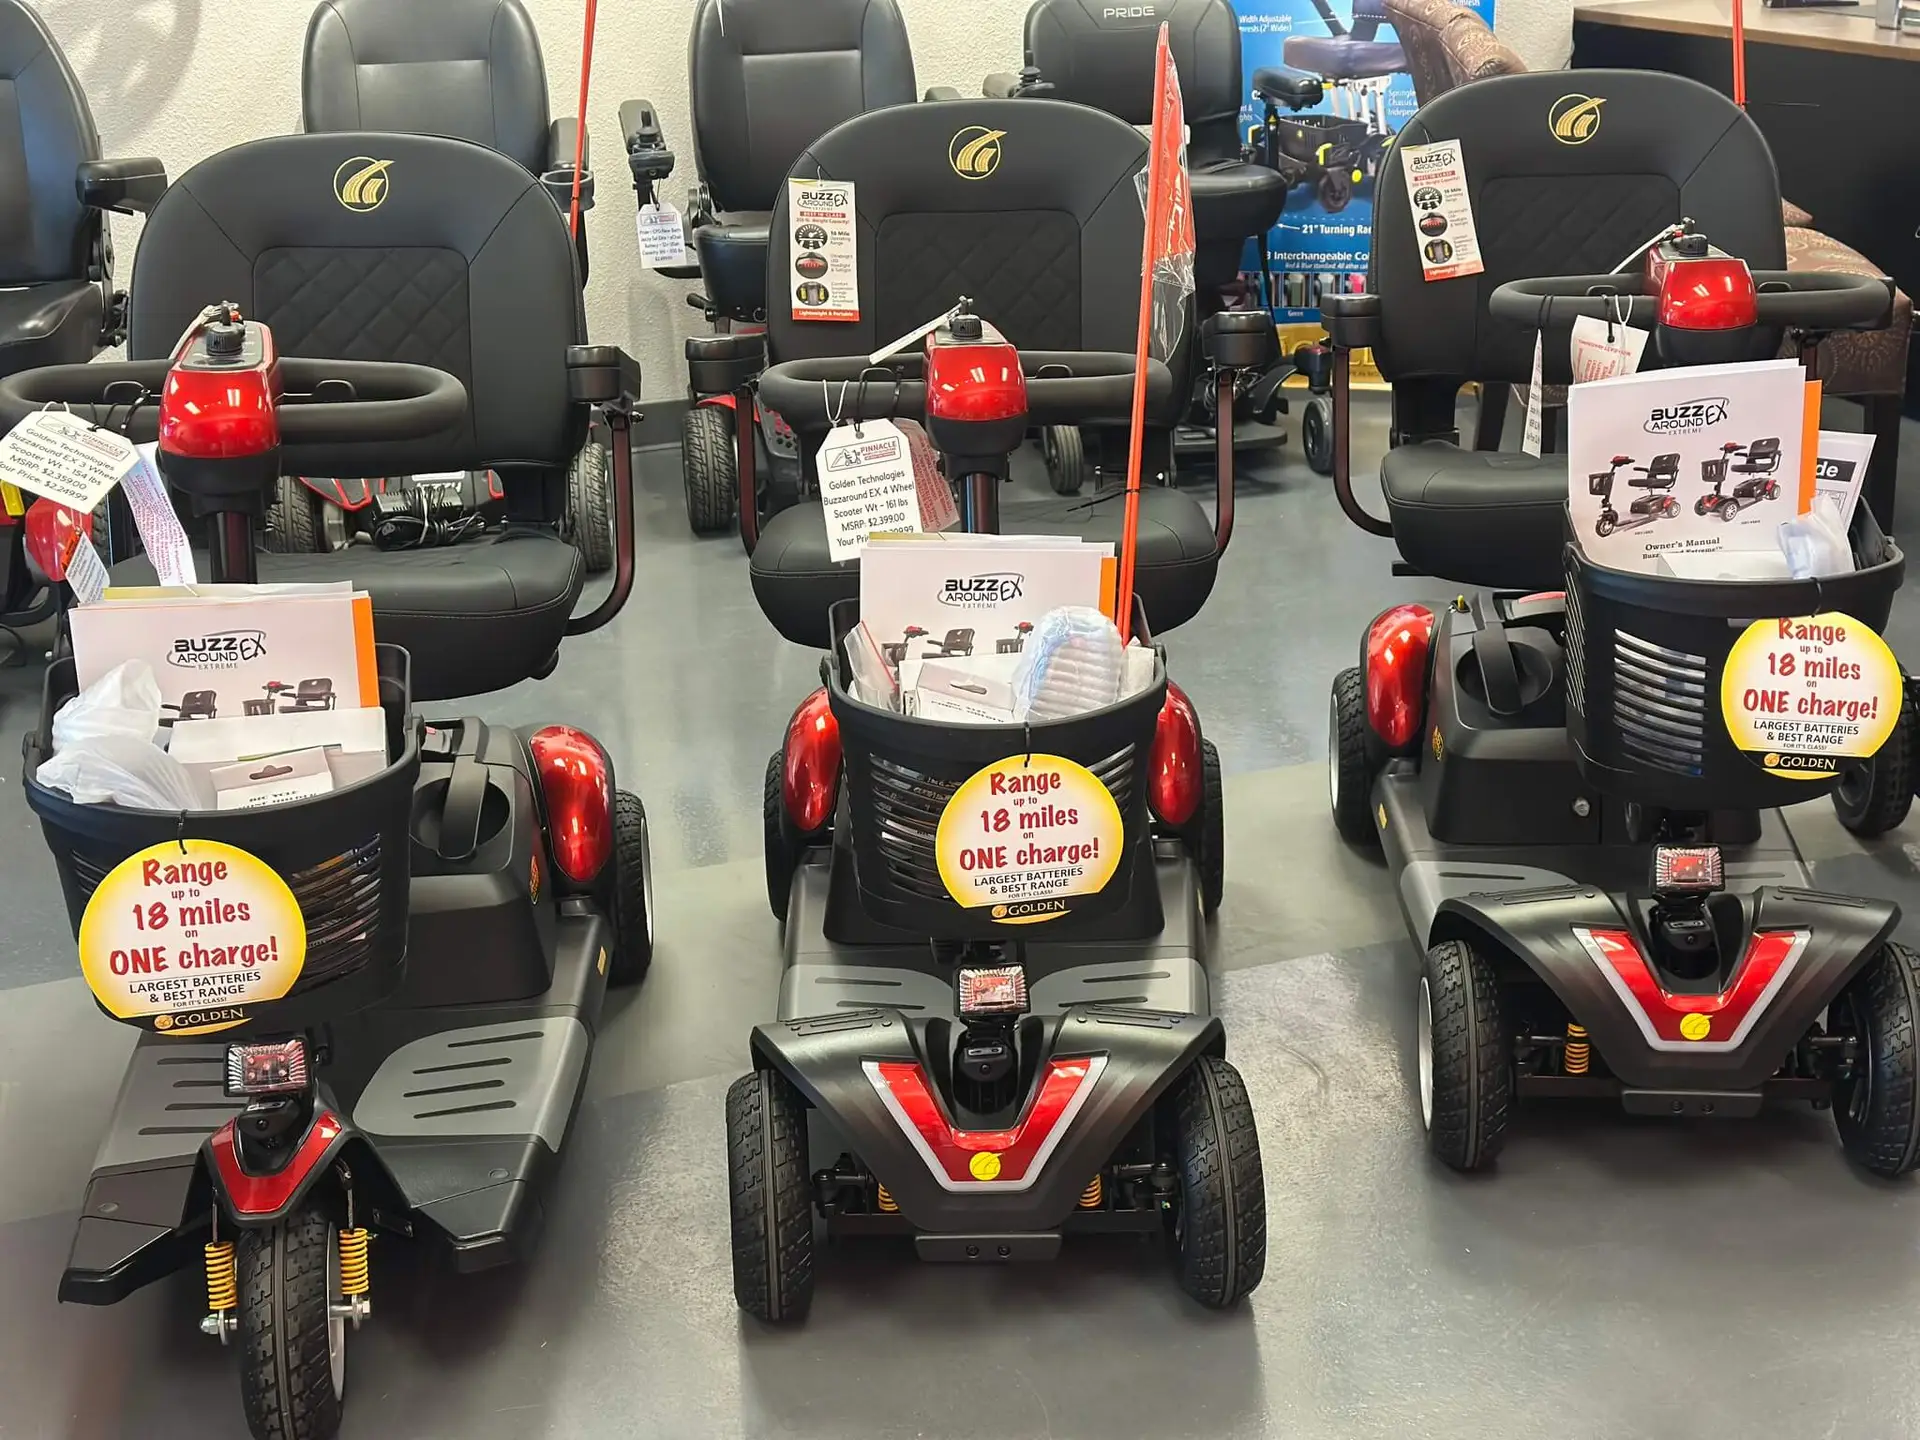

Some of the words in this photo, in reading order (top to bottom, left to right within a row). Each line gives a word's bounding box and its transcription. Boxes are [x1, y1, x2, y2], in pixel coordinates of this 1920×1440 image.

[1103, 6, 1155, 18] PRIDE
[1414, 154, 1441, 164] BUZZ
[1415, 162, 1443, 170] AROUND
[1442, 150, 1456, 166] EX
[802, 192, 834, 200] BUZZ
[834, 191, 848, 207] EX
[1302, 224, 1318, 234] 21"
[1320, 224, 1355, 237] Turning
[1274, 251, 1352, 262] Interchangeable
[1354, 252, 1370, 260] Col
[1651, 405, 1704, 421] BUZZ
[1706, 400, 1728, 425] EX
[1652, 418, 1704, 430] AROUND
[26, 428, 57, 445] Golden
[60, 442, 115, 472] Technologies
[860, 441, 897, 454] PINNACLE
[9, 431, 62, 458] Buzzaround
[62, 454, 76, 464] EX
[88, 465, 118, 482] Wheel
[9, 442, 44, 462] Scooter
[47, 458, 62, 469] Wt
[72, 468, 88, 480] 154
[88, 476, 102, 486] lbs
[10, 454, 40, 471] MSRP:
[17, 469, 42, 484] Price:
[828, 479, 856, 490] Golden
[857, 470, 905, 484] Technologies
[824, 492, 868, 506] Buzzaround
[869, 486, 880, 494] EX
[882, 486, 888, 494] 4
[890, 481, 914, 493] Wheel
[834, 507, 862, 518] Scooter
[865, 504, 878, 513] Wt
[886, 500, 896, 508] 161
[898, 498, 908, 506] lbs
[841, 521, 866, 532] MSRP:
[836, 536, 854, 547] Your
[856, 534, 869, 543] Pri
[1645, 540, 1682, 551] Owner's
[1686, 537, 1720, 547] Manual
[945, 579, 998, 592] BUZZ
[1000, 576, 1022, 601] EX
[946, 592, 998, 602] AROUND
[1778, 618, 1846, 646] Range
[174, 638, 238, 652] BUZZ
[240, 631, 266, 660] EX
[1800, 645, 1810, 654] up
[1814, 645, 1823, 653] to
[177, 652, 238, 663] AROUND
[198, 662, 238, 670] EXTREME
[1768, 652, 1796, 676] 18
[1804, 657, 1861, 680] miles
[1807, 680, 1817, 688] on
[1743, 689, 1789, 713] ONE
[1798, 692, 1878, 721] charge!
[1754, 720, 1801, 731] LARGEST
[1804, 723, 1858, 735] BATTERIES
[1767, 732, 1775, 740] &
[1778, 733, 1803, 742] BEST
[1806, 735, 1843, 744] RANGE
[1780, 756, 1836, 770] GOLDEN
[990, 772, 1061, 795] Range
[1013, 799, 1025, 807] up
[1028, 796, 1037, 804] to
[981, 808, 1010, 832] 18
[1019, 805, 1078, 829] miles
[960, 846, 1008, 871] ONE
[1016, 837, 1099, 864] charge!
[142, 859, 228, 886] Range
[974, 874, 1022, 887] LARGEST
[1026, 867, 1083, 881] BATTERIES
[171, 889, 185, 900] up
[189, 888, 200, 897] to
[990, 886, 998, 895] &
[1001, 884, 1026, 893] BEST
[1030, 879, 1069, 890] RANGE
[133, 901, 169, 930] 18
[179, 898, 251, 927] miles
[1008, 900, 1065, 916] GOLDEN
[185, 929, 198, 938] on
[110, 946, 169, 975] ONE
[179, 936, 278, 968] charge!
[130, 978, 187, 994] LARGEST
[193, 971, 261, 987] BATTERIES
[150, 993, 159, 1003] &
[164, 990, 194, 1001] BEST
[199, 984, 245, 997] RANGE
[175, 1007, 243, 1027] GOLDEN
